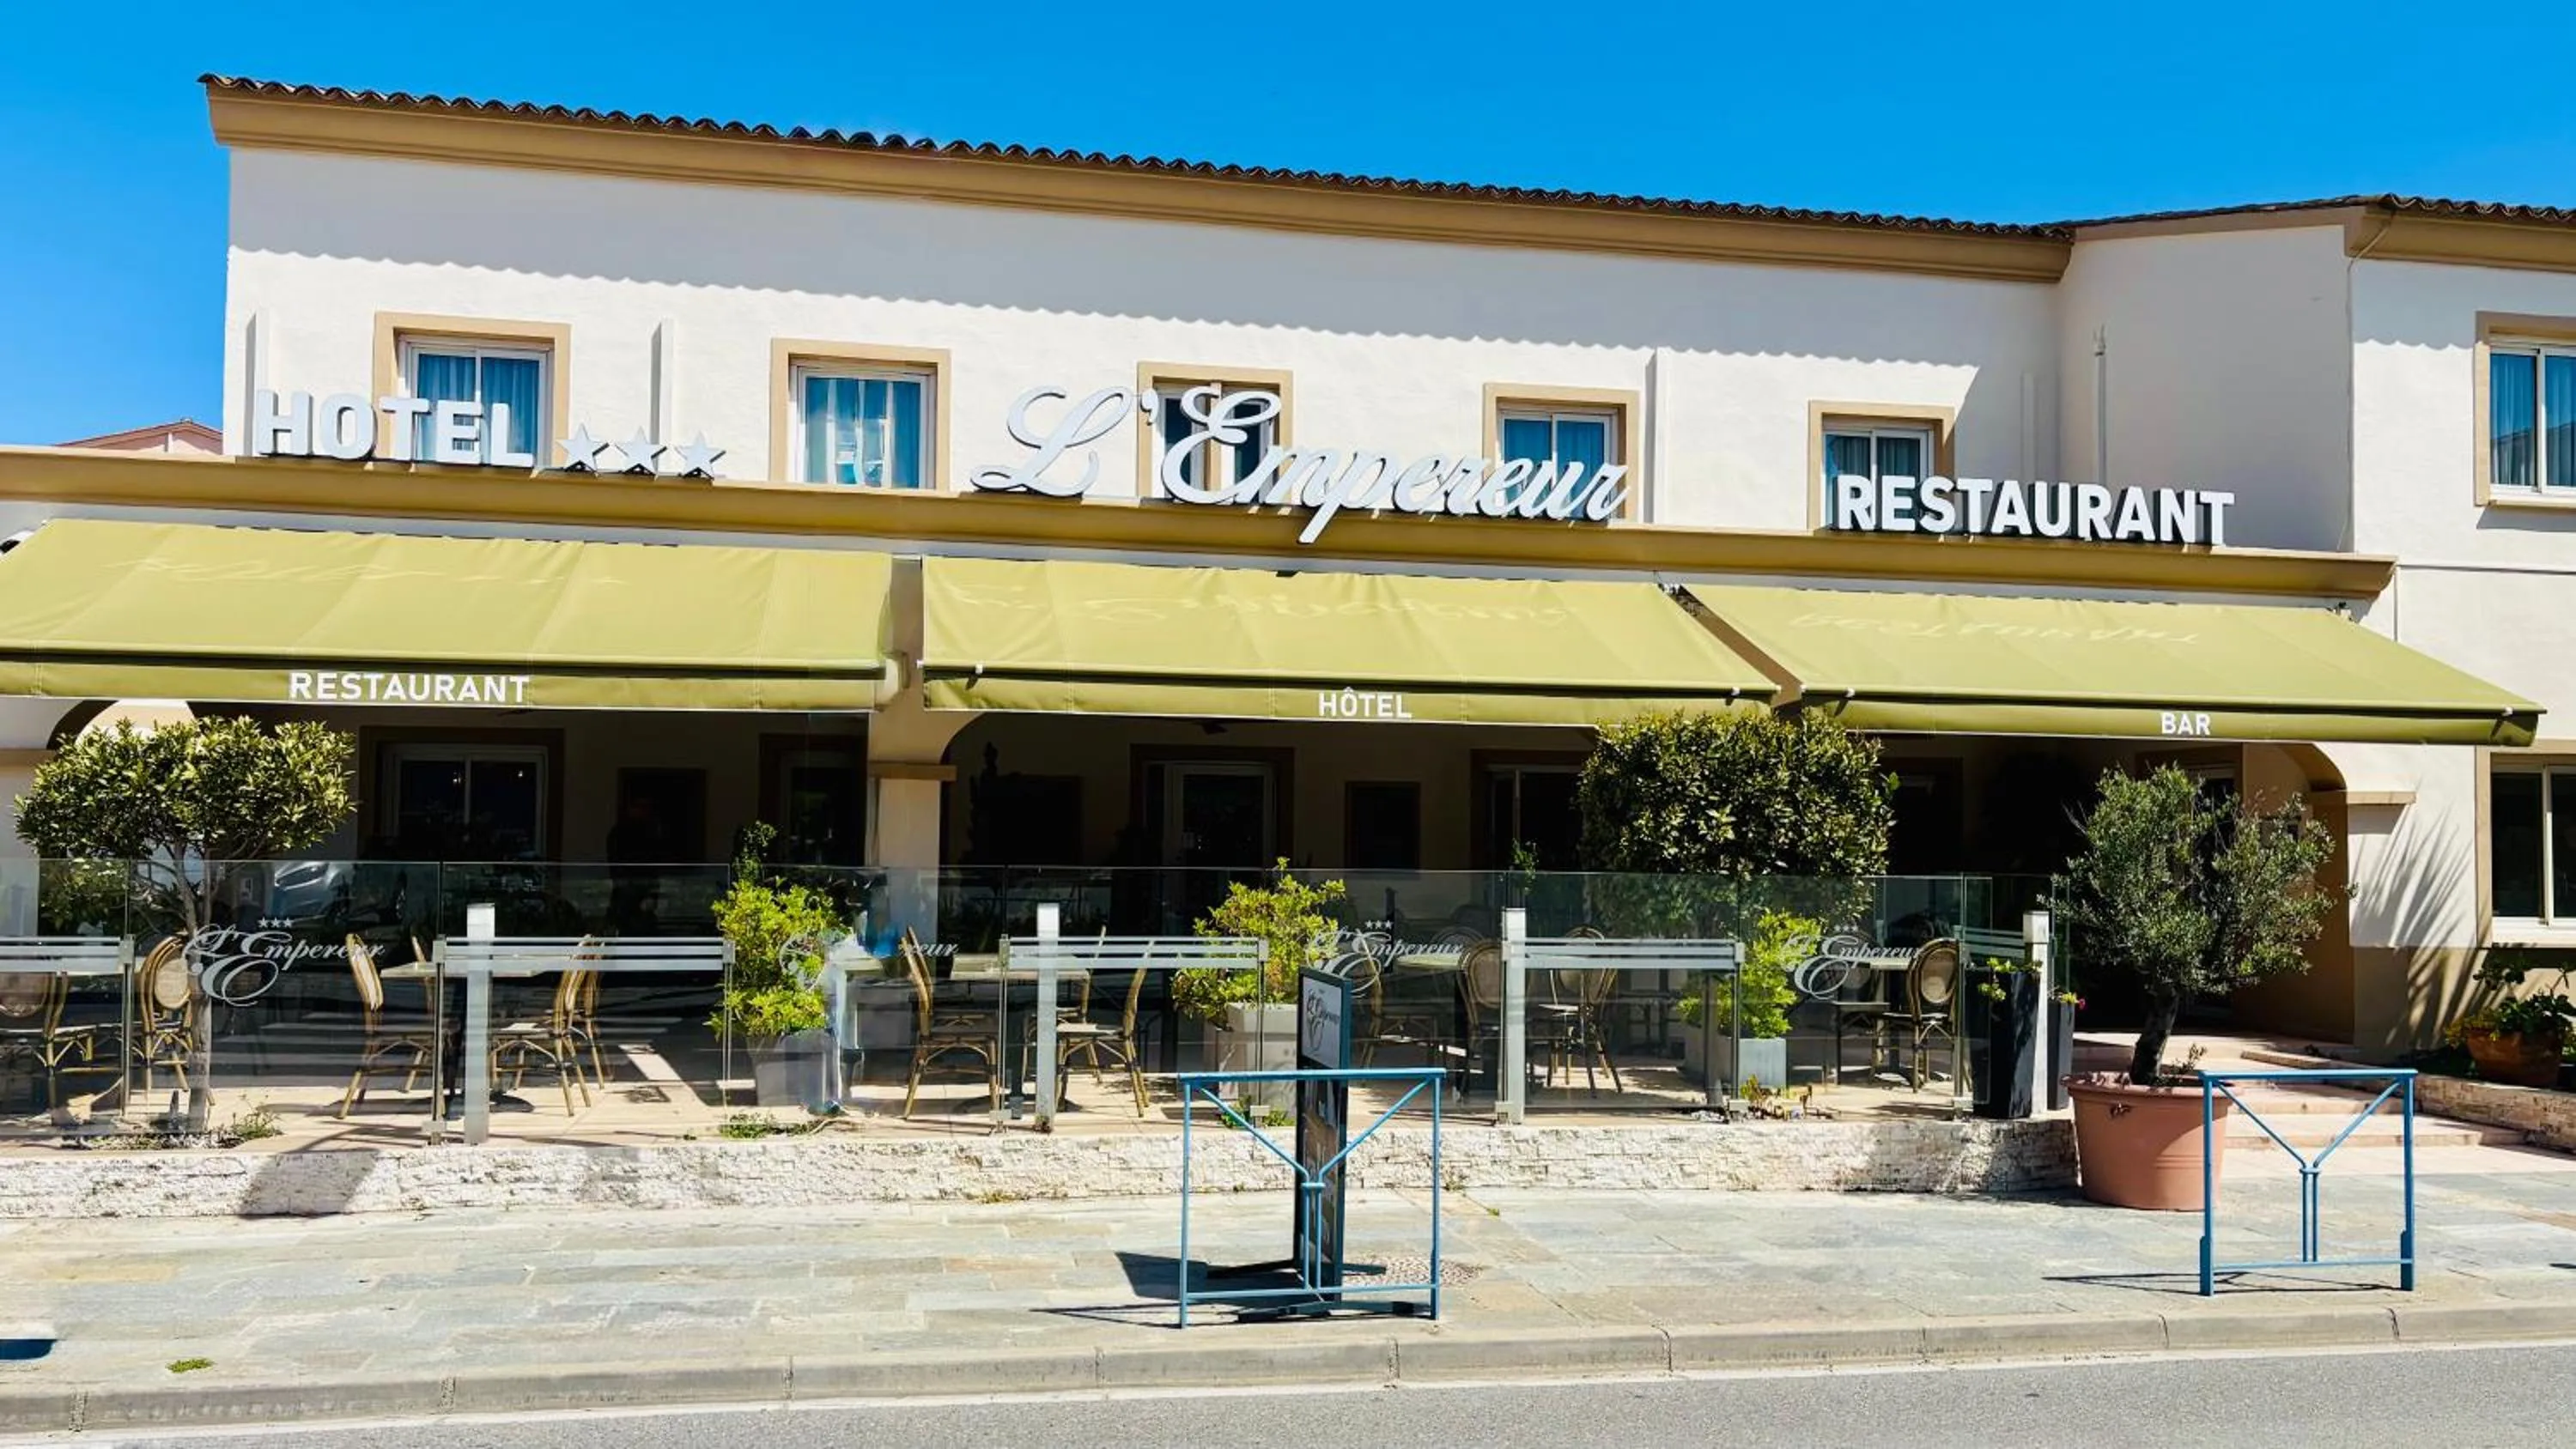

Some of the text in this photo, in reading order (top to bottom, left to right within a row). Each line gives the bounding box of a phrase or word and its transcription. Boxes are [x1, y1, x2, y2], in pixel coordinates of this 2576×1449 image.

[257, 389, 534, 469] HOTEL
[969, 384, 1633, 543] L'Empereur
[1833, 474, 2235, 546] RESTAURANT
[289, 670, 531, 704] RESTAURANT
[1318, 687, 1413, 720] HÔTEL
[2160, 711, 2212, 737] BAR
